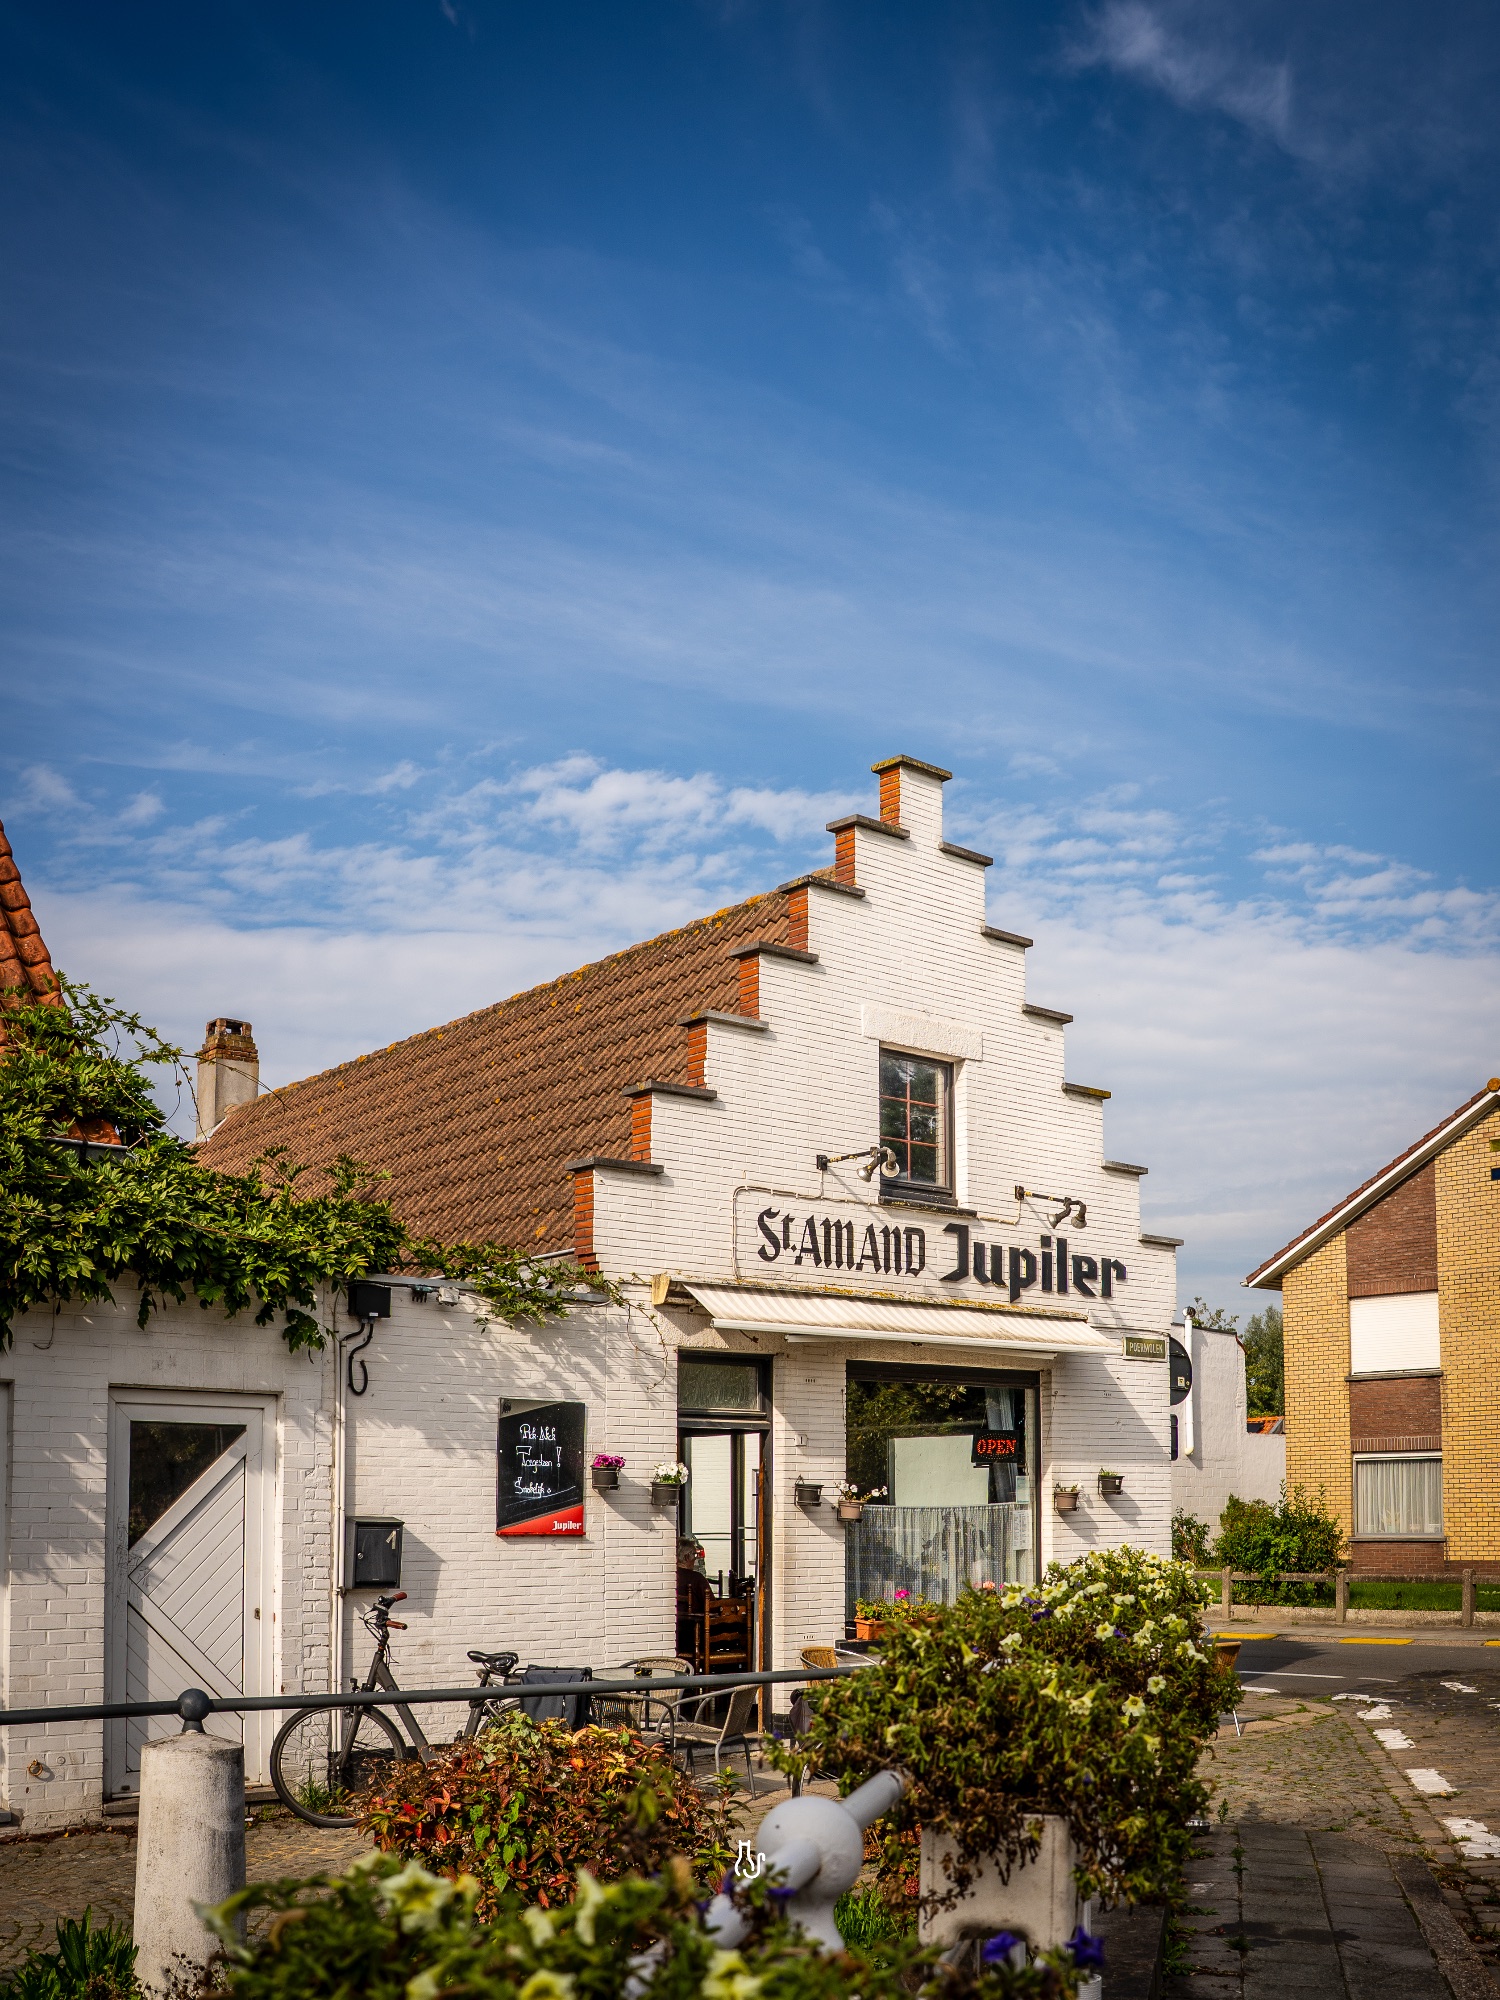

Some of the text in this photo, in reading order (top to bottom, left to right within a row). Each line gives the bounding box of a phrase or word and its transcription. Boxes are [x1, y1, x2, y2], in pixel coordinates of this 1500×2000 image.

[939, 1223, 1127, 1303] Jupiler
[976, 1439, 1017, 1454] OPEN
[552, 1520, 582, 1532] Jupiler
[385, 1530, 397, 1550] 1
